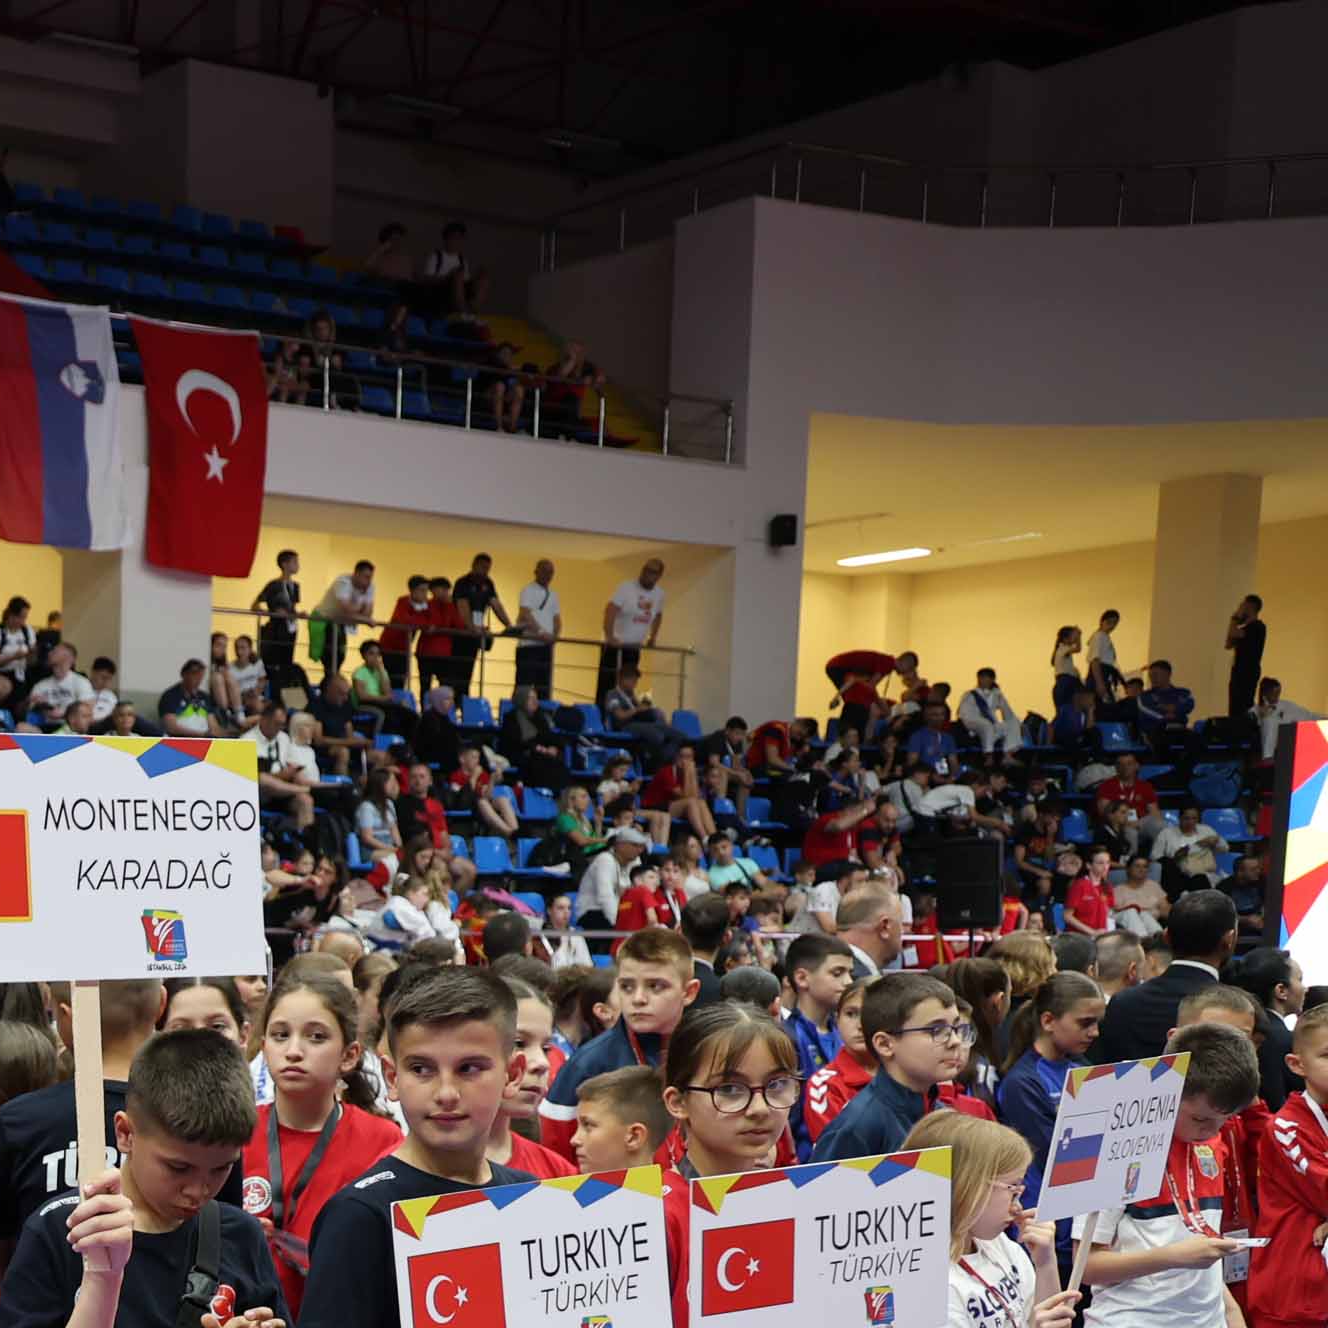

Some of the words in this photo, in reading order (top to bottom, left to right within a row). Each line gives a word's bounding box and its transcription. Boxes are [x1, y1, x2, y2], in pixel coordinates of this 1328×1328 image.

[44, 797, 257, 832] MONTENEGRO
[76, 851, 233, 891] KARADAĞ
[1110, 1094, 1177, 1131] SLOVENIA
[1107, 1133, 1165, 1162] SLOVENYA
[815, 1200, 936, 1253] TURKIYE
[521, 1222, 650, 1281] TURKIYE
[829, 1246, 922, 1287] TÜRKİYE
[540, 1273, 640, 1315] TÜRKİYE
